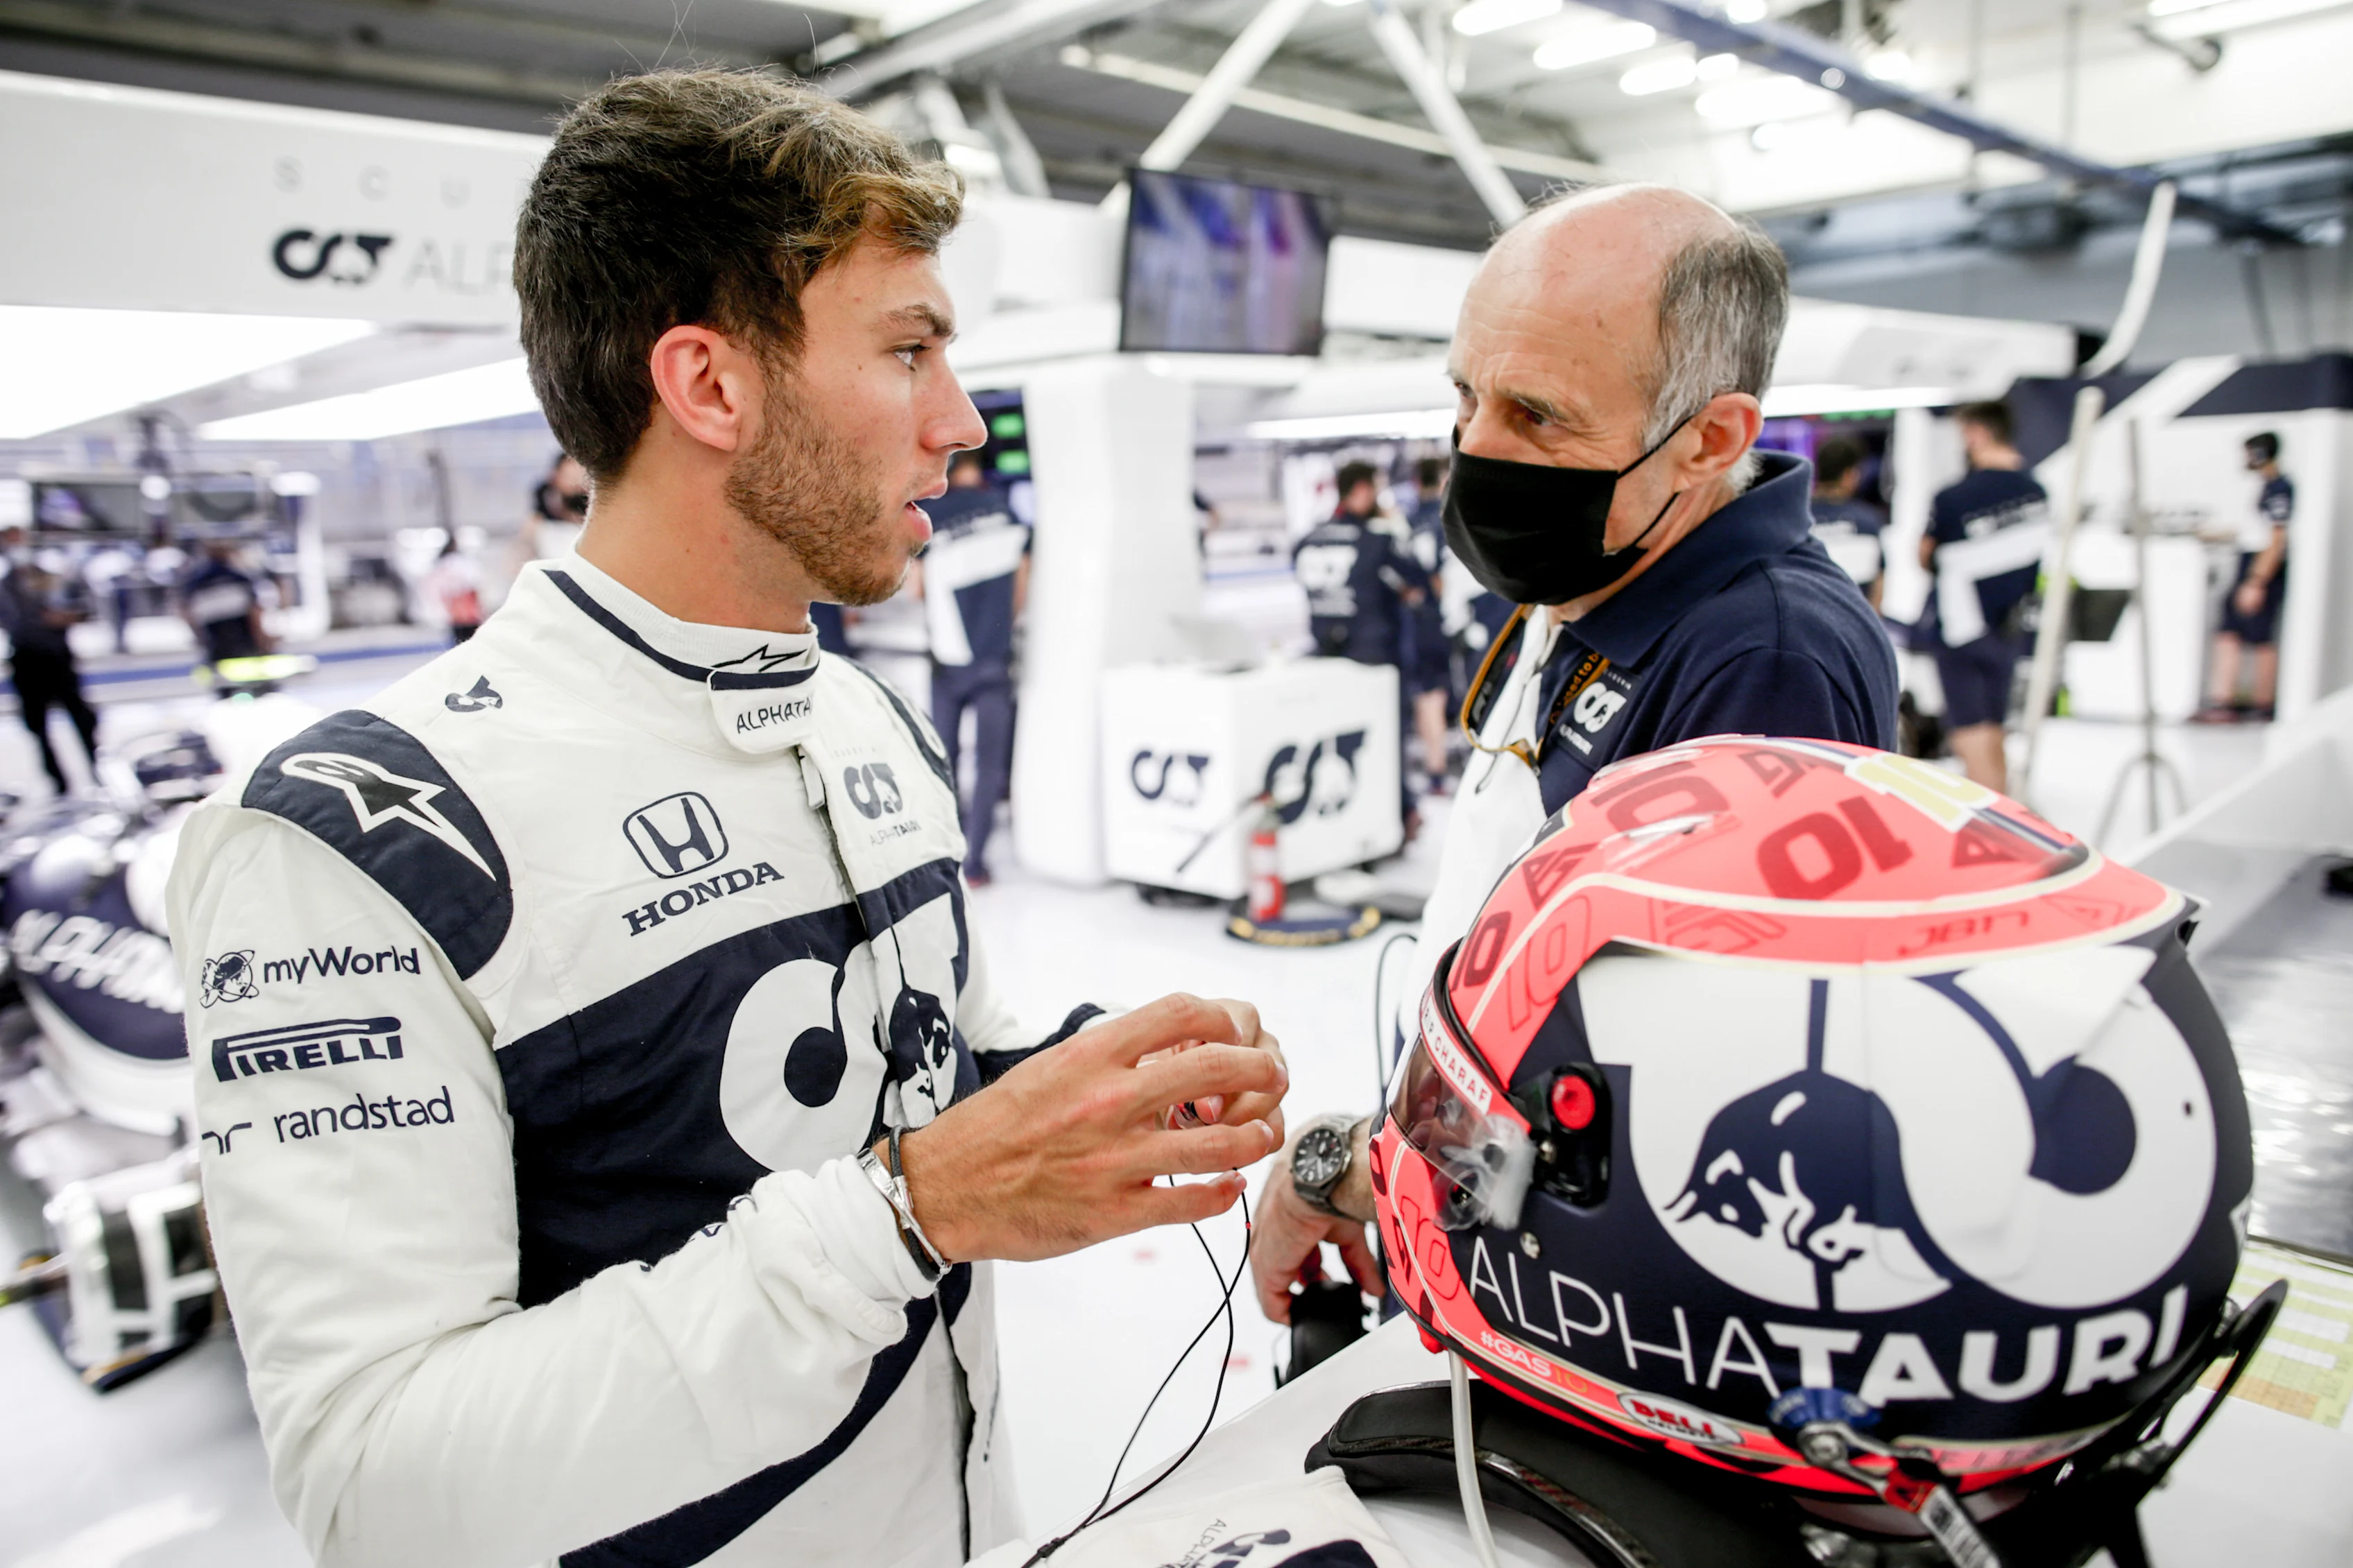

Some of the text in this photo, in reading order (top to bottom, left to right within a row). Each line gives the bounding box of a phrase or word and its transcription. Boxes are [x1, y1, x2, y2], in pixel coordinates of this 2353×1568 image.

[622, 861, 785, 938] HONDA
[264, 945, 421, 984] myWorld
[212, 1016, 404, 1082] PIRELLI
[1434, 1035, 1489, 1103] CHARAF
[274, 1085, 455, 1143] randstad
[1469, 1236, 2189, 1408] ALPHATAURI
